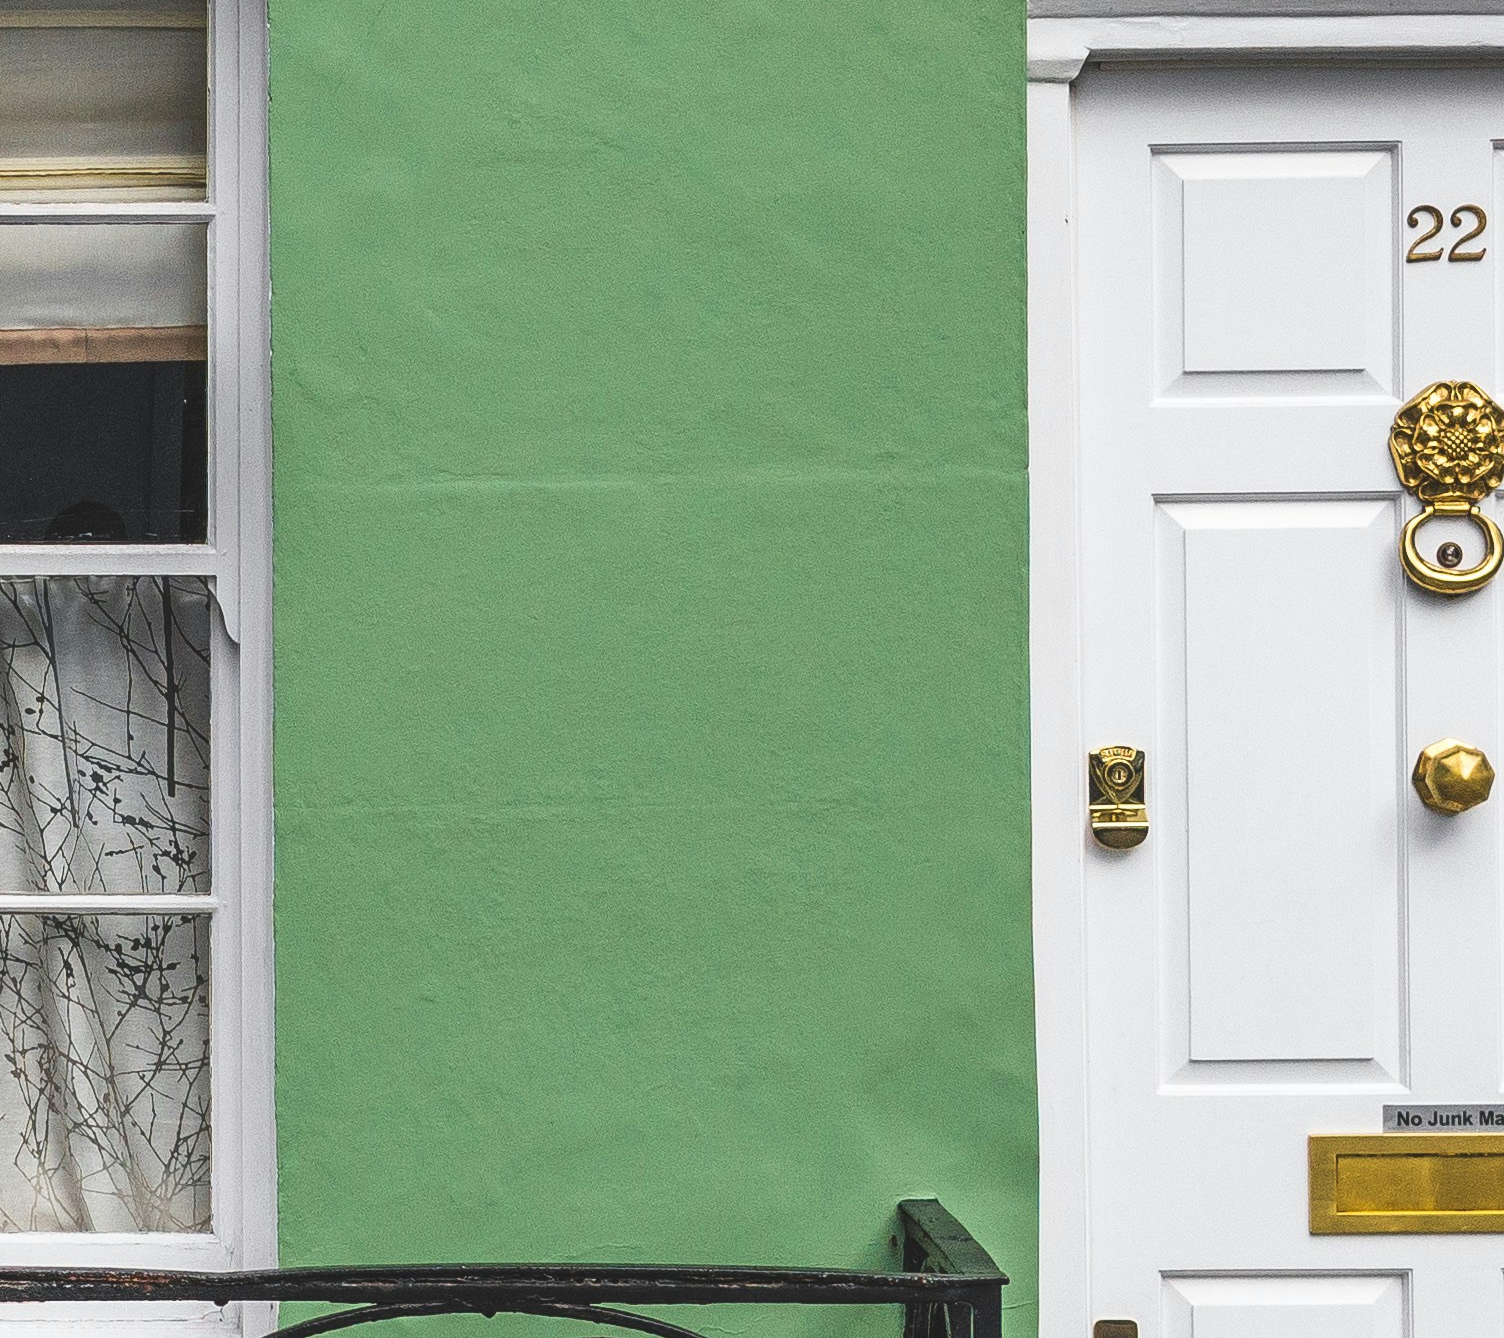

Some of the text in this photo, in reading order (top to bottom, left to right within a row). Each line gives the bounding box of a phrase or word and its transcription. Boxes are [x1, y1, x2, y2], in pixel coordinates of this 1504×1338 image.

[1405, 204, 1487, 264] 22
[1397, 1111, 1423, 1127] No
[1427, 1110, 1474, 1127] Junk
